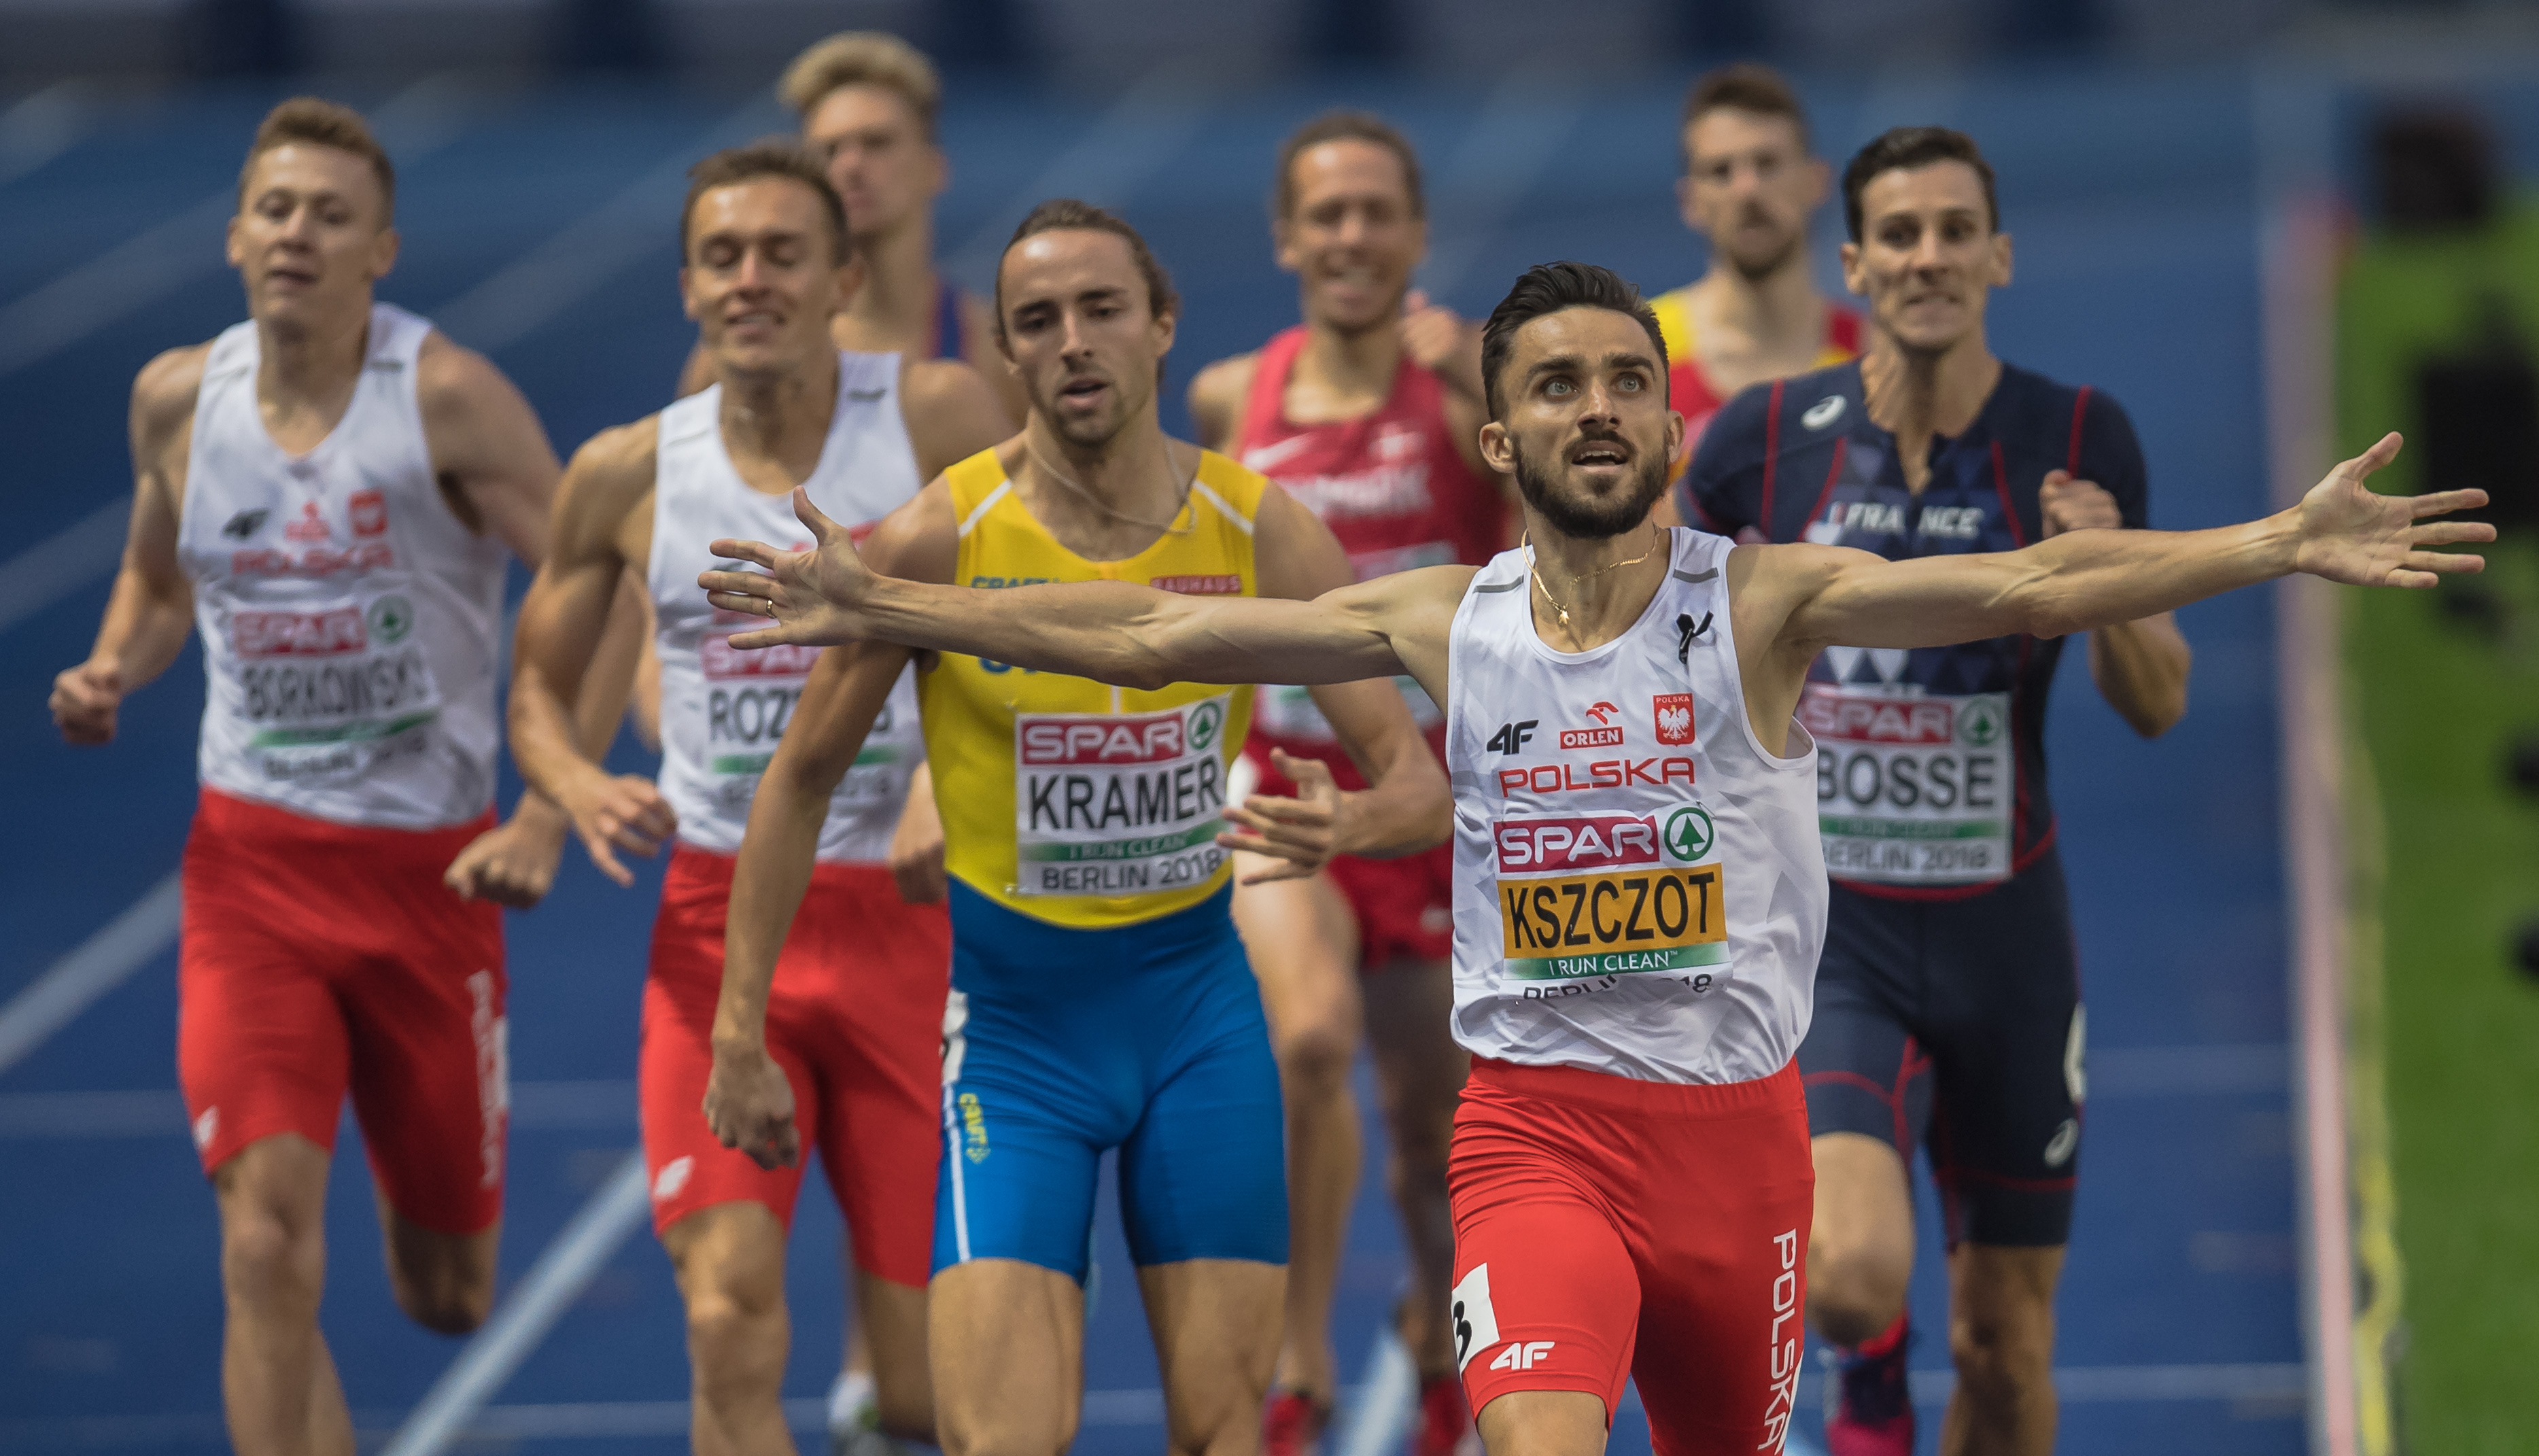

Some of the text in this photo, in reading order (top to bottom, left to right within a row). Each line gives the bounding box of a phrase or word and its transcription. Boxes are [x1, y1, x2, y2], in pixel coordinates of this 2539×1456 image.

[1844, 502, 1984, 539] FRANCE
[1656, 695, 1691, 704] POLSKA
[1806, 697, 1950, 738] SPAR
[1025, 720, 1180, 760] SPAR
[1487, 719, 1539, 755] 4F
[1563, 729, 1620, 747] ORLEN
[1029, 755, 1222, 831] KRAMER
[1498, 757, 1695, 797] POLSKA
[1817, 748, 1994, 809] BOSSE
[1499, 823, 1655, 864] SPAR
[1042, 848, 1222, 891] BERLIN 2018
[1507, 872, 1714, 949] KSZCZOT
[1559, 957, 1597, 975] RUN
[1489, 1342, 1555, 1370] 4F
[1757, 1228, 1797, 1452] POLSKA
